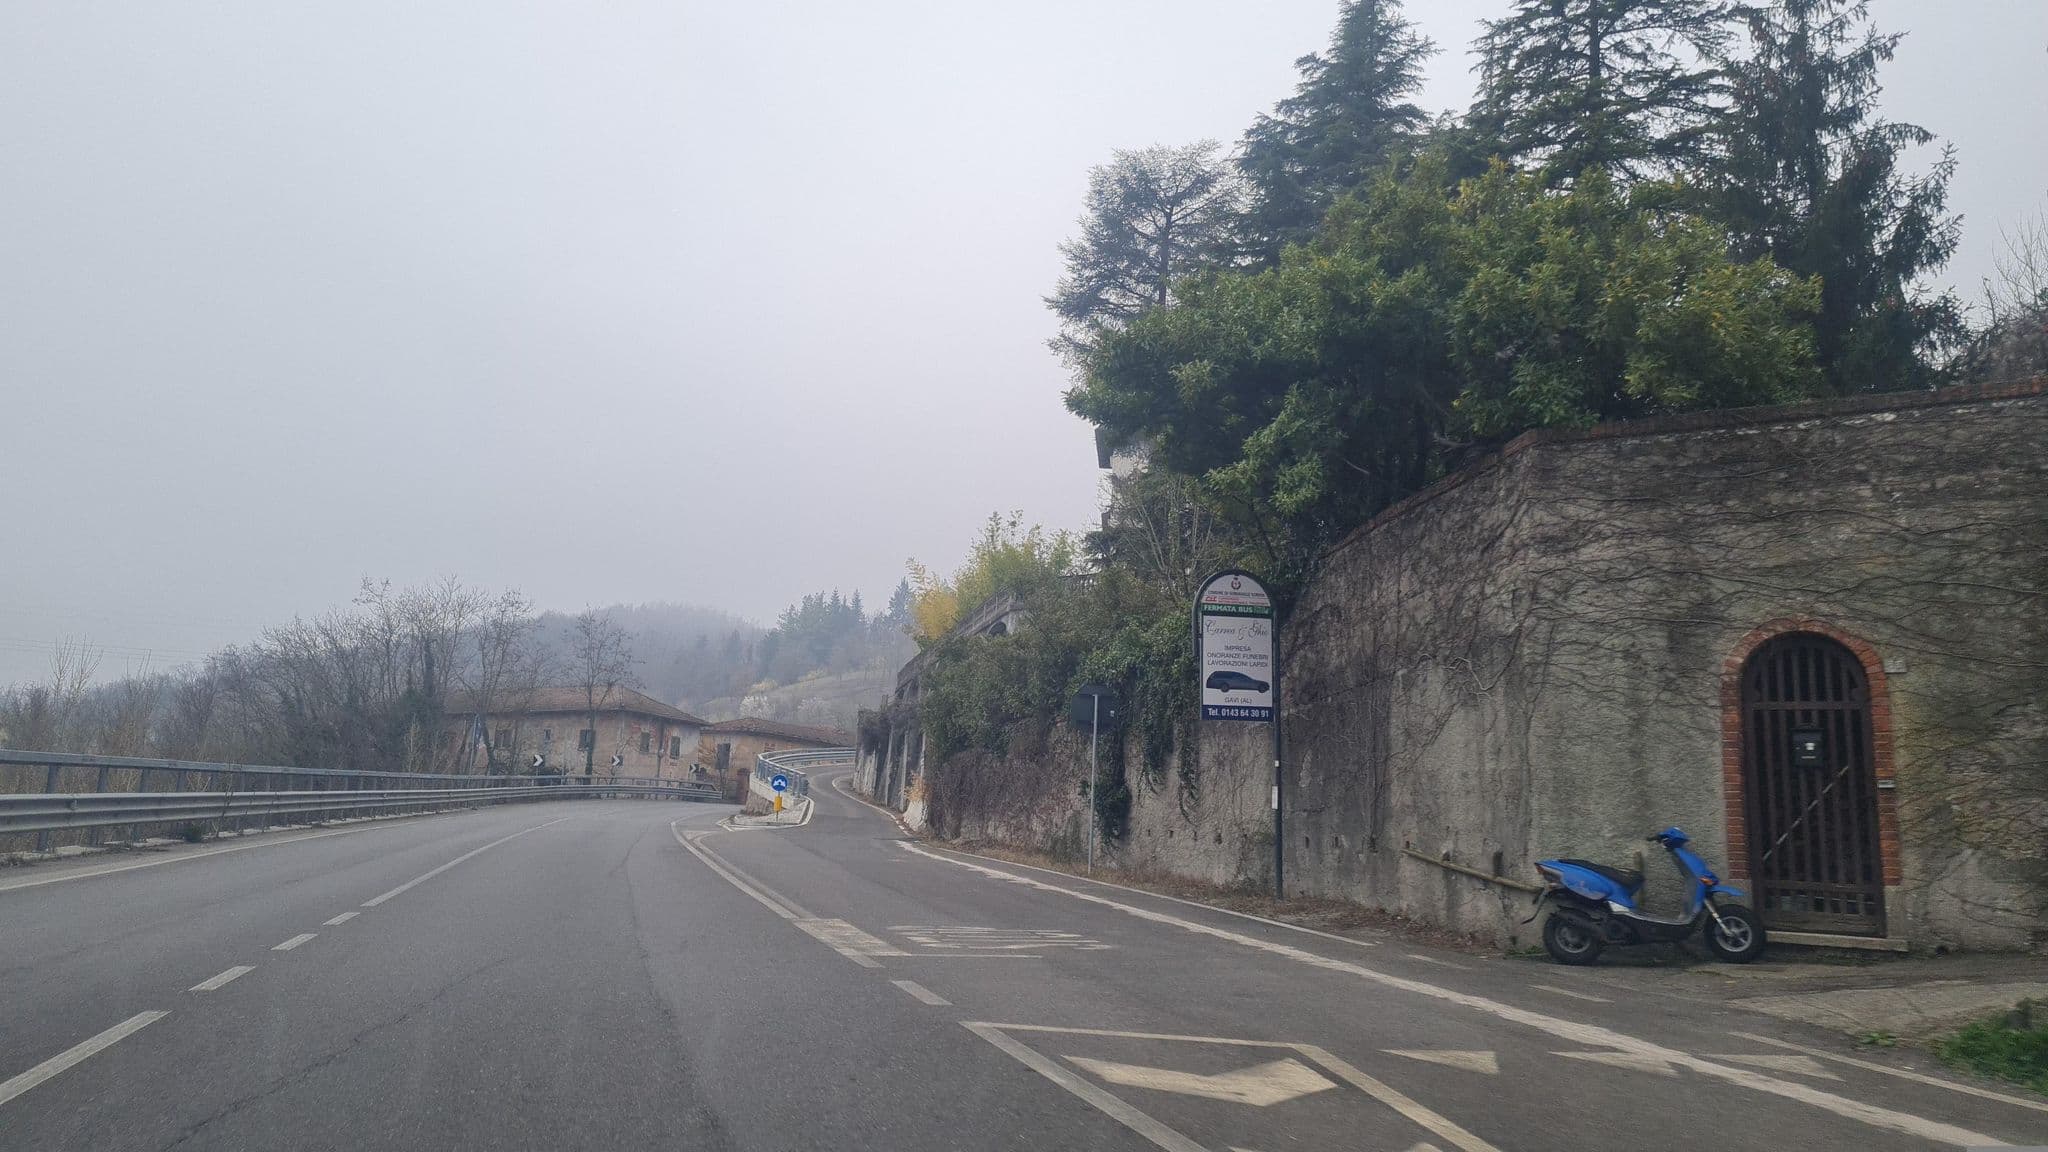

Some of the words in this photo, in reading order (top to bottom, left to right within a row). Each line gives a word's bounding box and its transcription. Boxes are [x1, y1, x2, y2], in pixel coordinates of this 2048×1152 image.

[1204, 604, 1237, 612] FERMATA
[1208, 708, 1219, 716] Tel.
[1221, 708, 1238, 717] 0143
[1240, 709, 1249, 717] 64
[1260, 710, 1269, 718] 91
